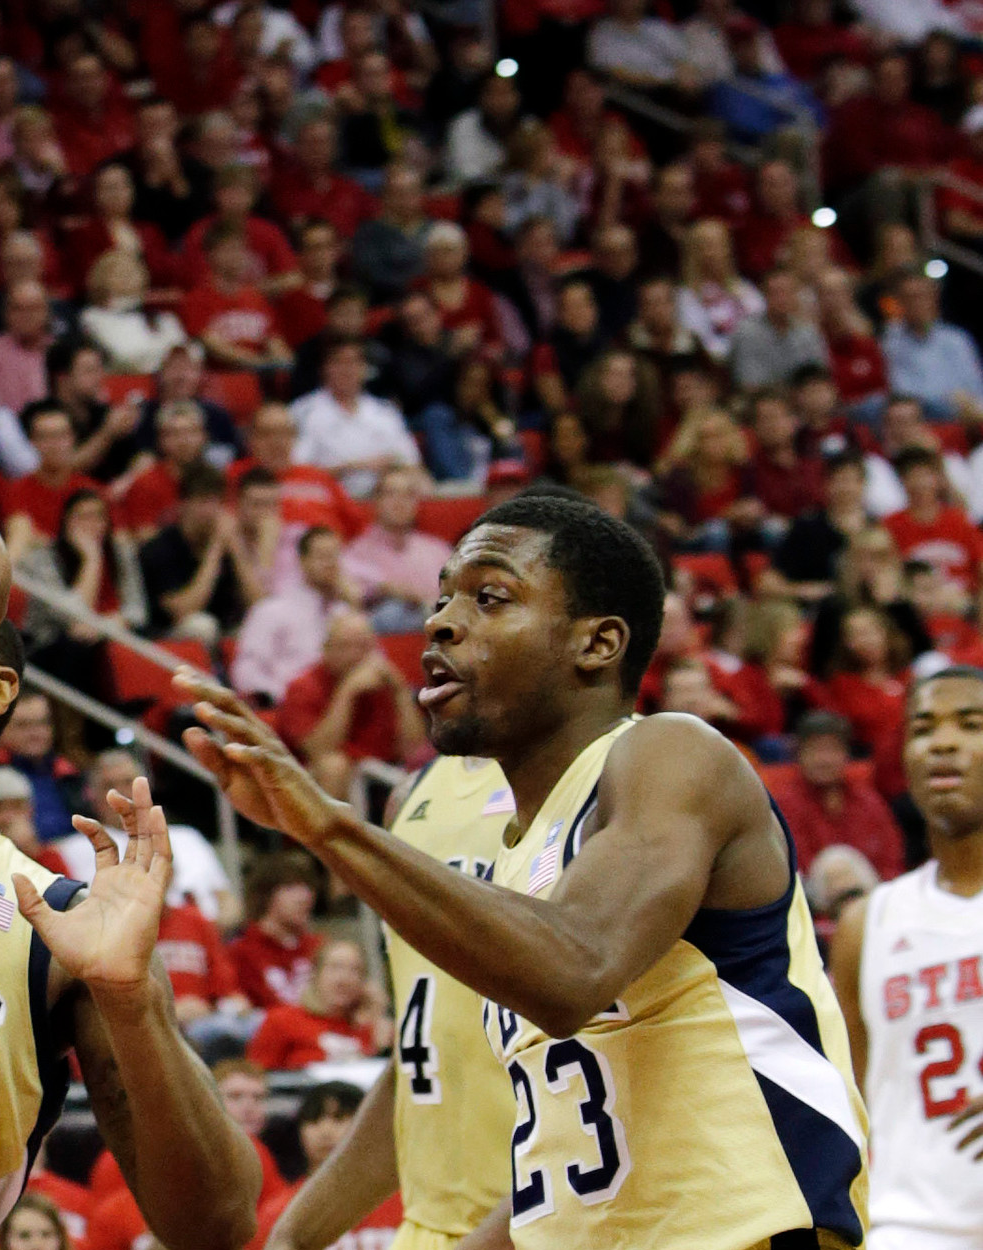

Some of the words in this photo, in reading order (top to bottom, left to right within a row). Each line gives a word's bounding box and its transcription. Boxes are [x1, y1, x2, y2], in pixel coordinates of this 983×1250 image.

[397, 974, 441, 1105] 4
[914, 1022, 983, 1119] 2
[508, 1036, 634, 1230] 23
